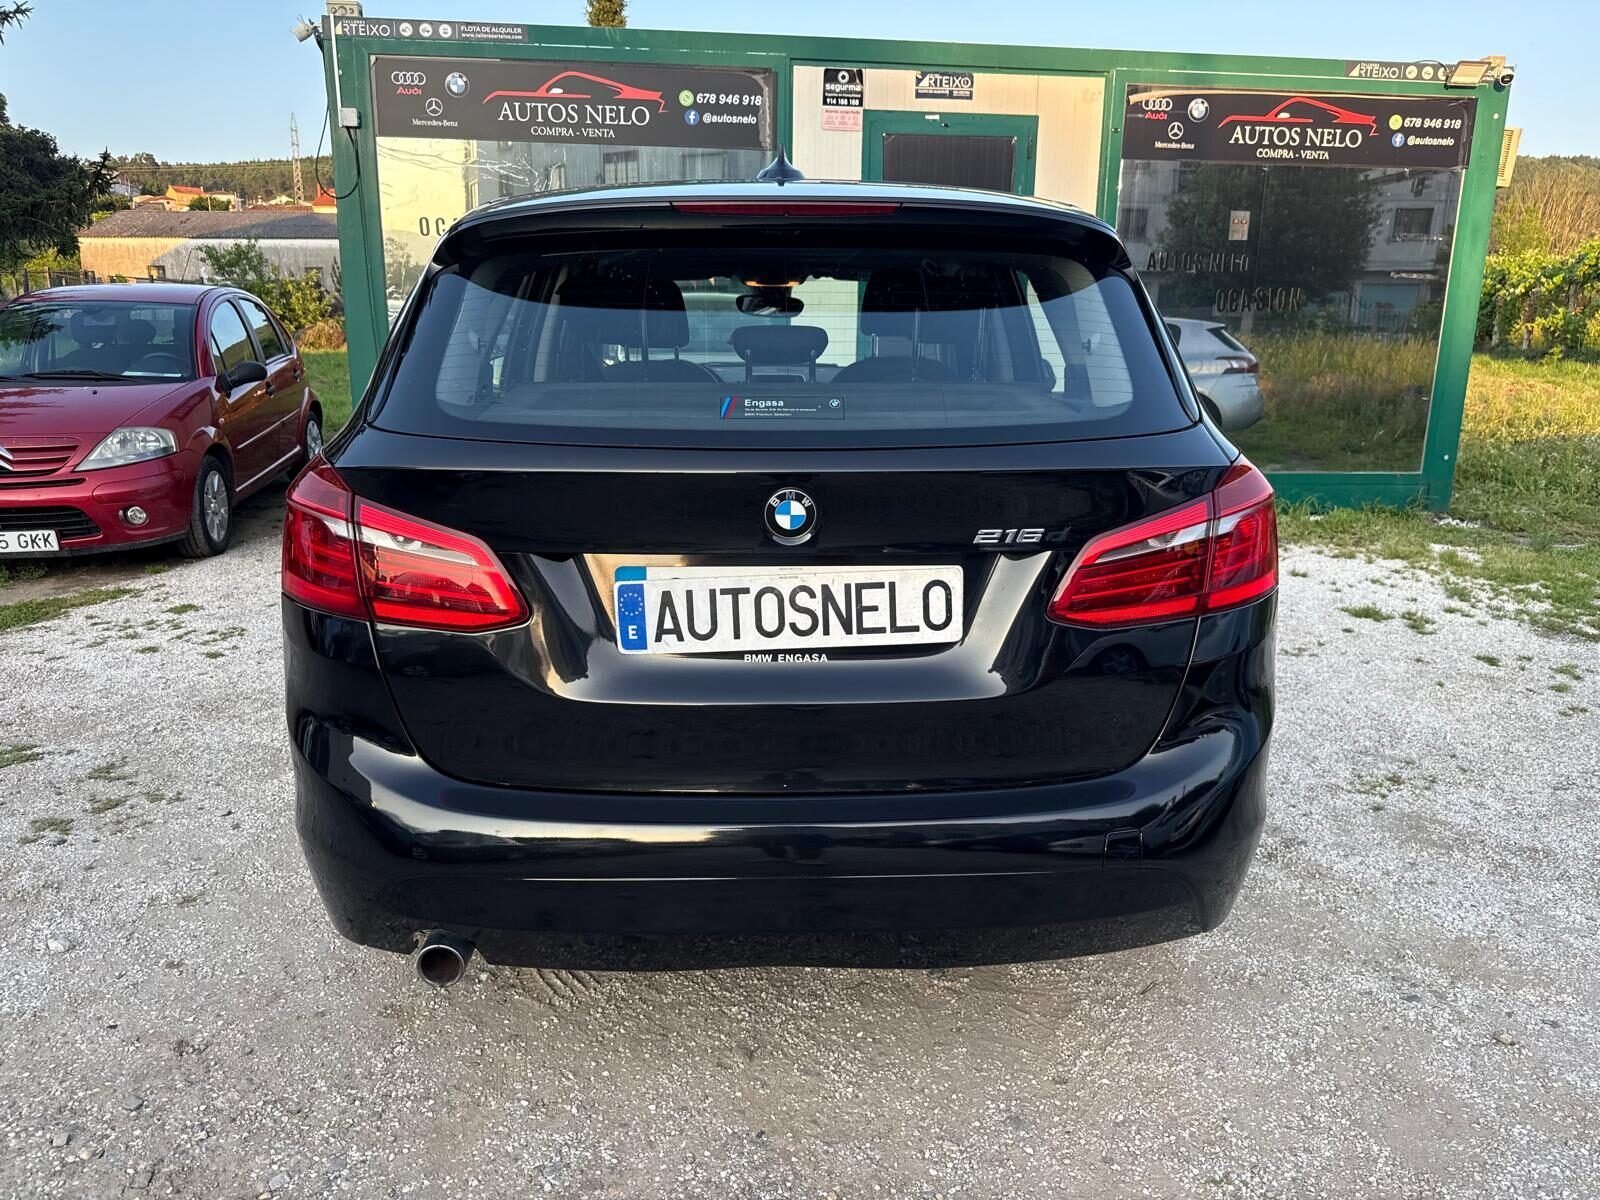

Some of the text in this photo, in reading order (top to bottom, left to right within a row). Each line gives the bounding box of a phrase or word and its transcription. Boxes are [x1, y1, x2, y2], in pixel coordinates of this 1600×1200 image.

[397, 86, 422, 95] Audi
[825, 83, 862, 92] segurma
[696, 92, 762, 106] 678 946 918
[497, 101, 651, 126] AUTOS NELO
[702, 112, 758, 125] @autosnelo
[1144, 111, 1169, 121] Audi
[412, 118, 459, 127] Mercedes-Benz
[1403, 117, 1462, 130] 678 946 918
[530, 126, 575, 137] COMPRA
[581, 128, 616, 138] VENTA
[1229, 125, 1363, 149] AUTOS NELO
[1406, 135, 1455, 146] @autosnelo
[1256, 148, 1294, 159] COMPRA
[1301, 150, 1330, 160] VENTA
[419, 216, 457, 237] OC
[744, 399, 784, 408] Engasa
[770, 490, 812, 508] BMW
[17, 532, 54, 549] GKK
[654, 579, 953, 643] AUTOSNELO
[628, 625, 638, 639] E
[743, 653, 828, 662] BMW ENGASA
